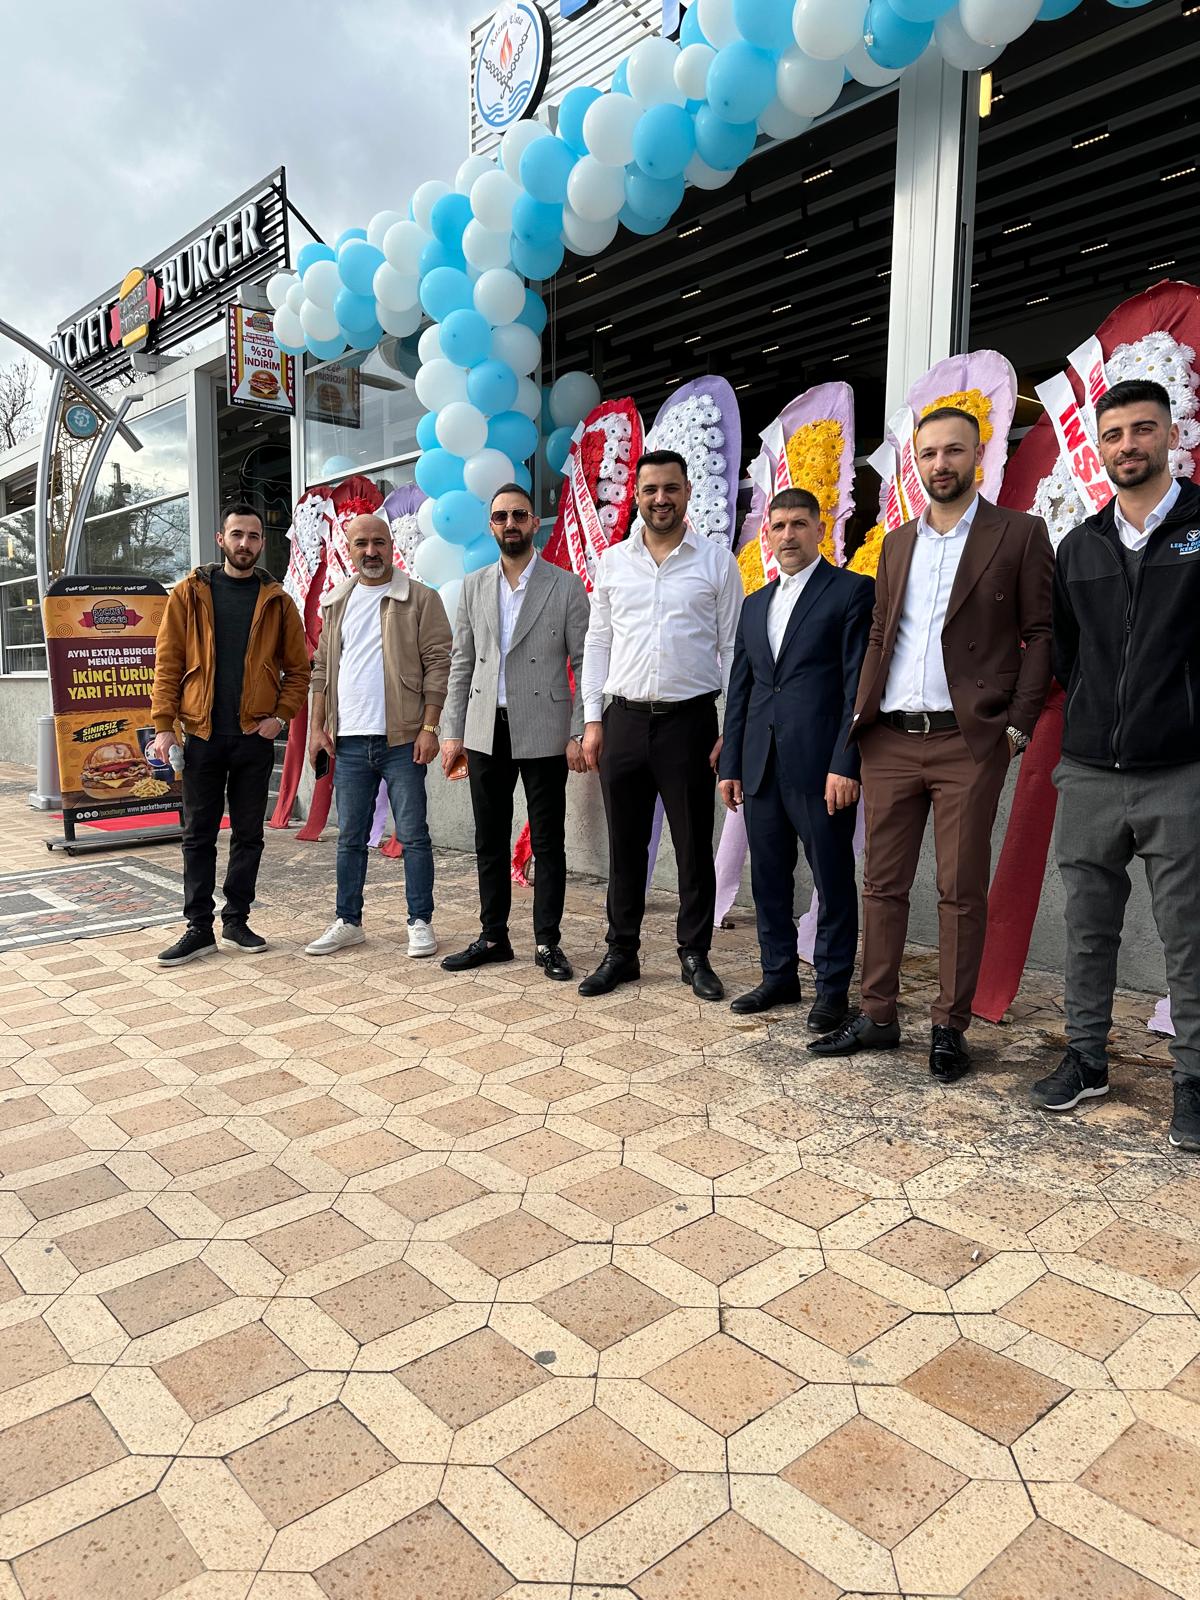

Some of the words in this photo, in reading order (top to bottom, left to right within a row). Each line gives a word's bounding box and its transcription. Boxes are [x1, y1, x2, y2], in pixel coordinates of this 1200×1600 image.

[47, 304, 109, 367] PACKET
[162, 202, 263, 310] BURGER
[251, 346, 273, 358] %30
[244, 354, 281, 371] İNDİRİM
[68, 650, 90, 658] AYNI
[91, 648, 121, 657] EXTRA
[88, 656, 142, 666] MENÜLERDE
[73, 667, 117, 684] İKİNCİ
[68, 686, 102, 700] YARI
[82, 721, 118, 736] SINIRSIZ
